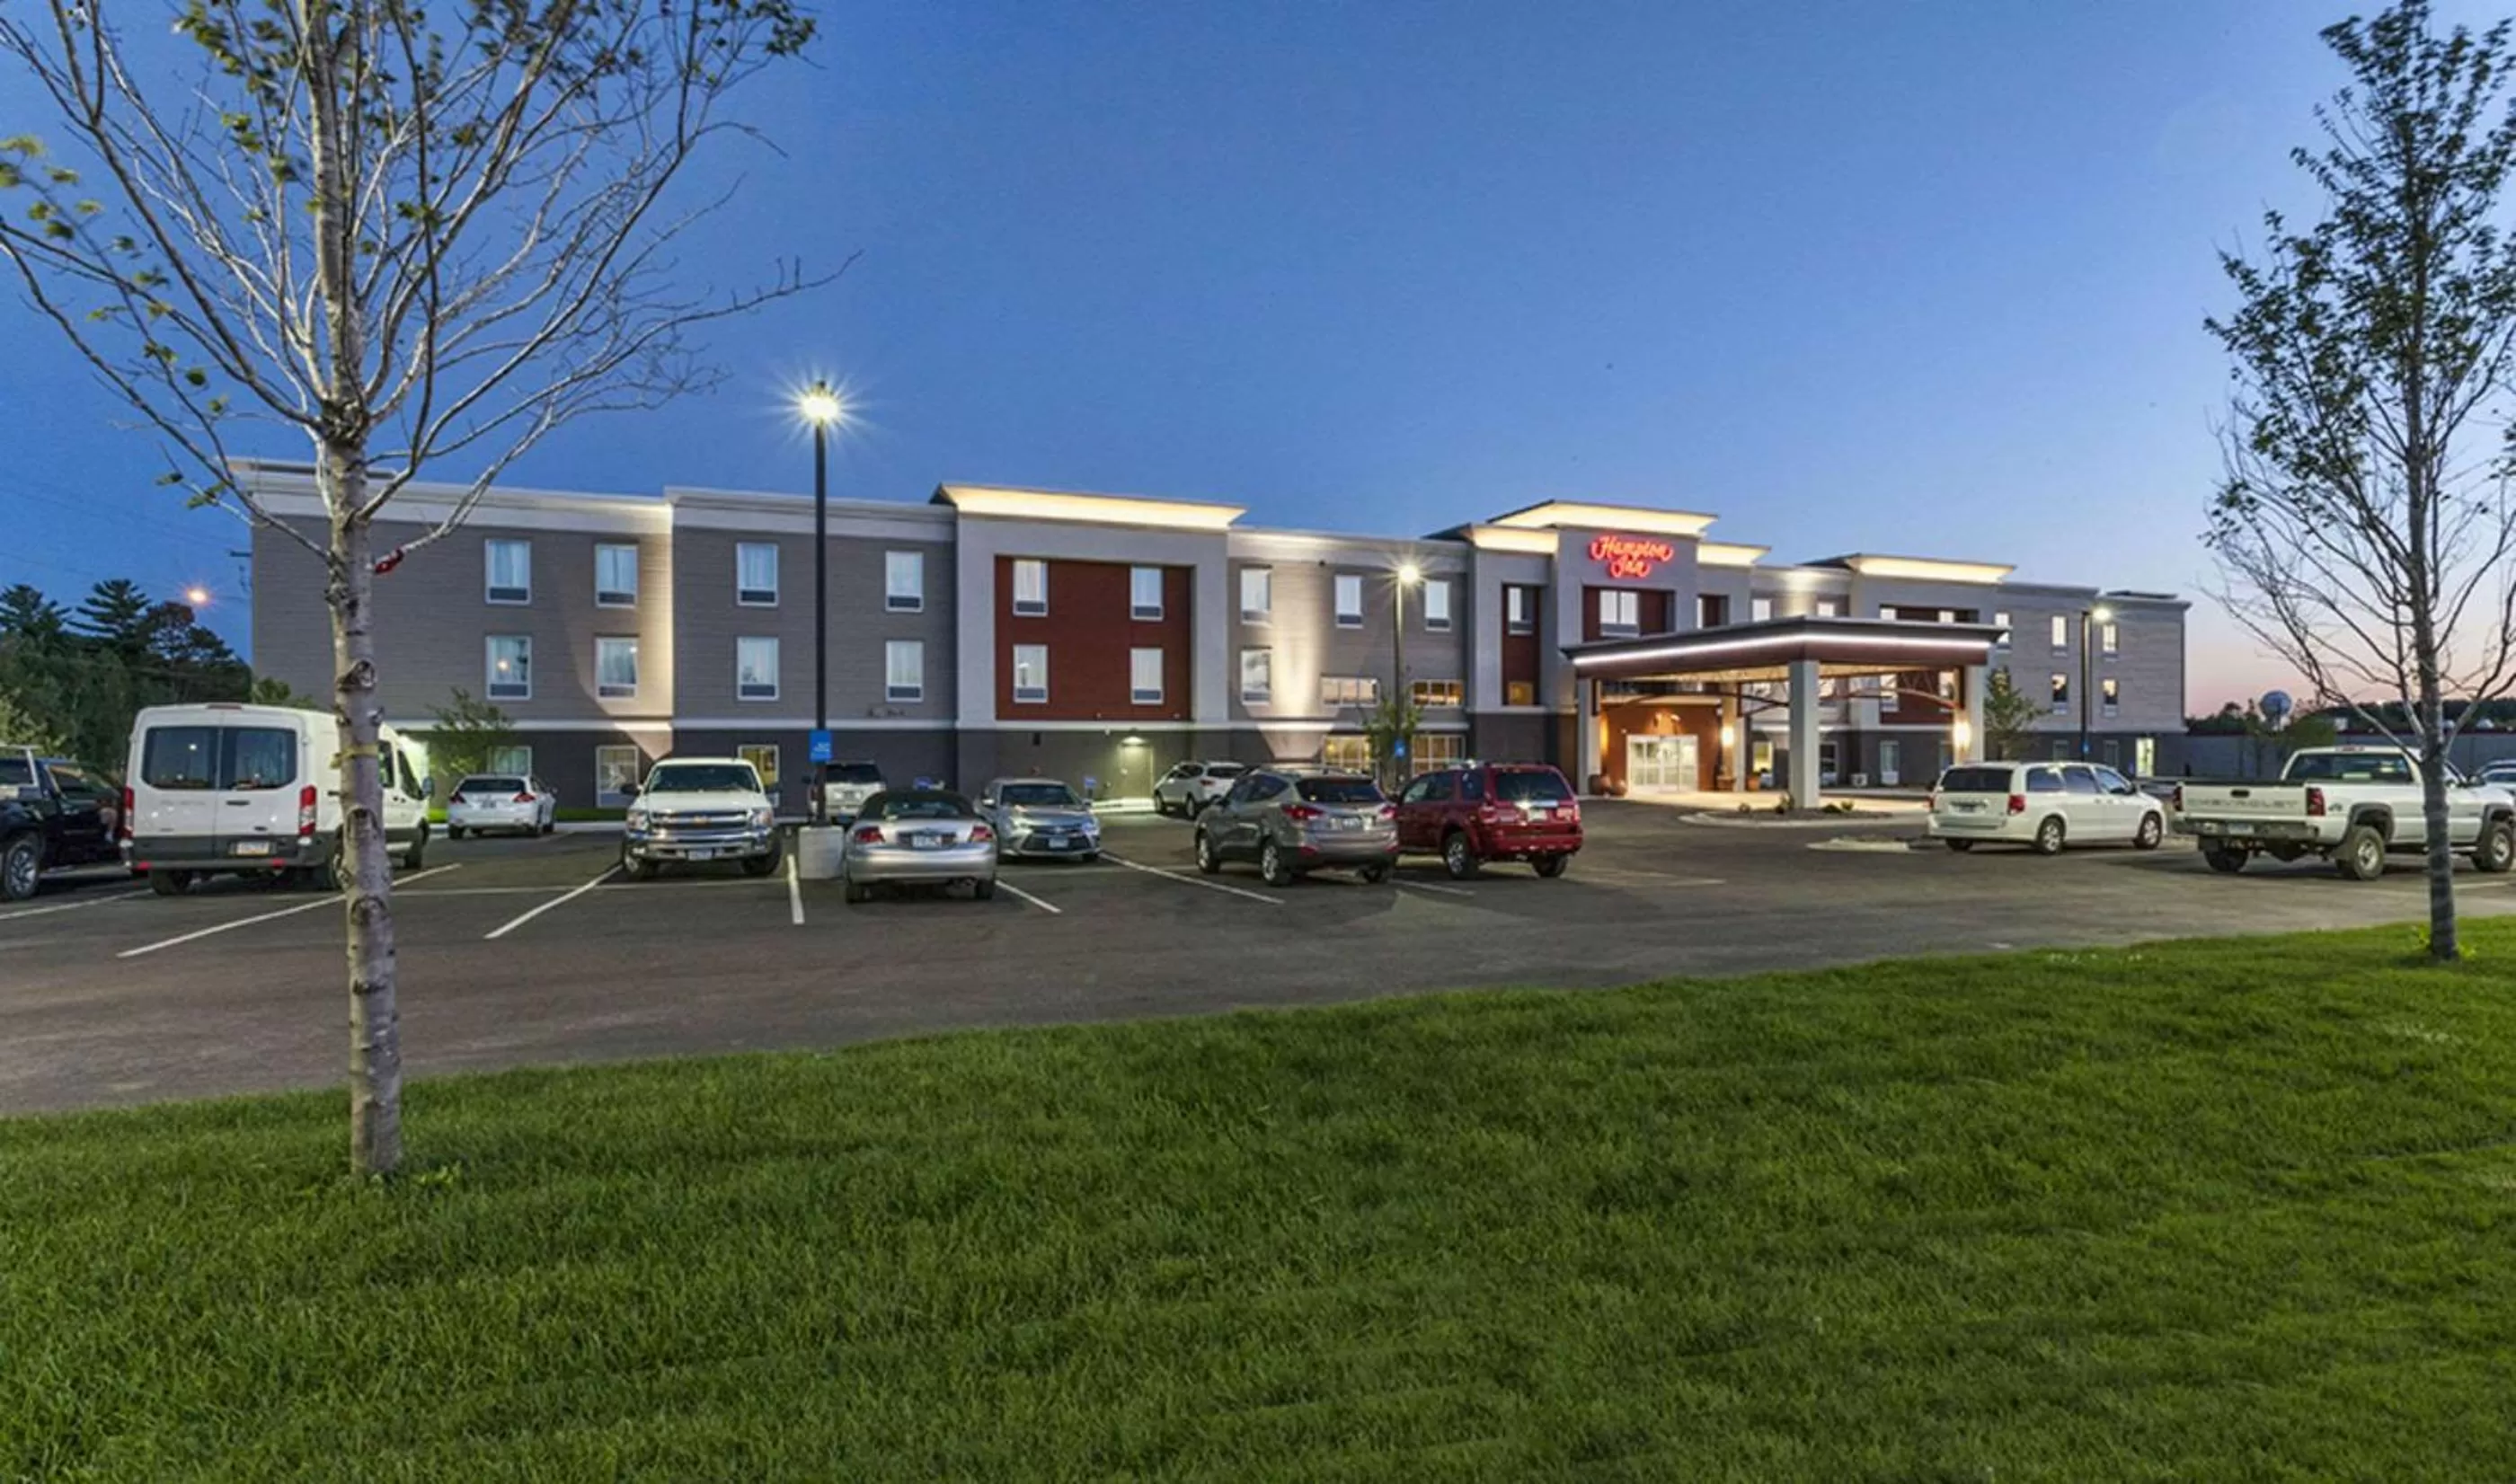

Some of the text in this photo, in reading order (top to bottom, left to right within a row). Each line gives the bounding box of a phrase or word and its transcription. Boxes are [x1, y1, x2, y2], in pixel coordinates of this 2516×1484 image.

[1590, 535, 1674, 561] Hampton
[1609, 553, 1651, 578] Inn
[2186, 798, 2298, 808] CHEVROLET
